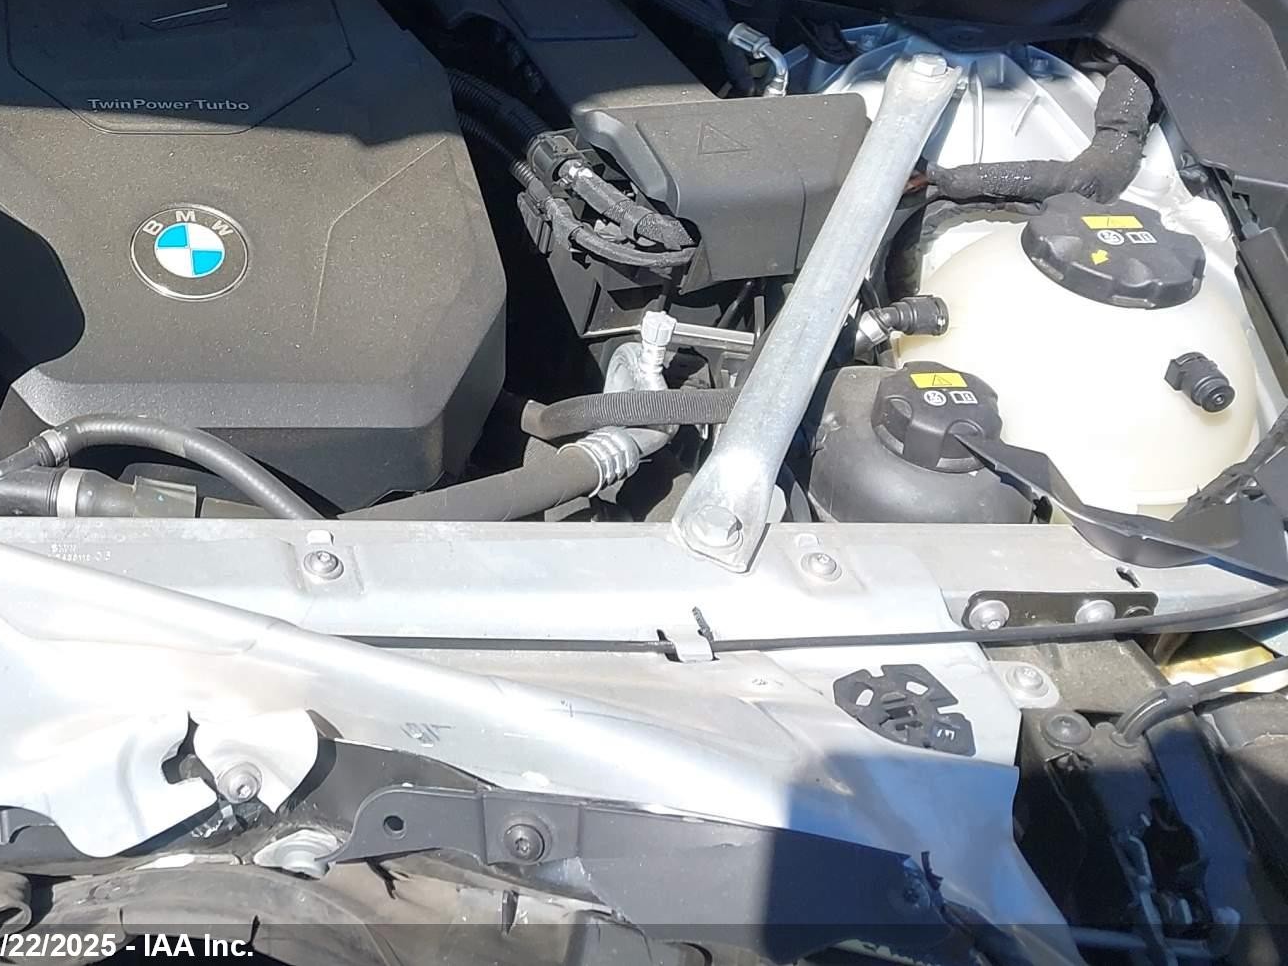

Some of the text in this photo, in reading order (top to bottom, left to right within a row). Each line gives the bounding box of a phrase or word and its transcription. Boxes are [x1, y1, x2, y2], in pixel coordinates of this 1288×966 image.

[87, 98, 250, 112] TwinPower Turbo
[142, 209, 234, 237] BMW
